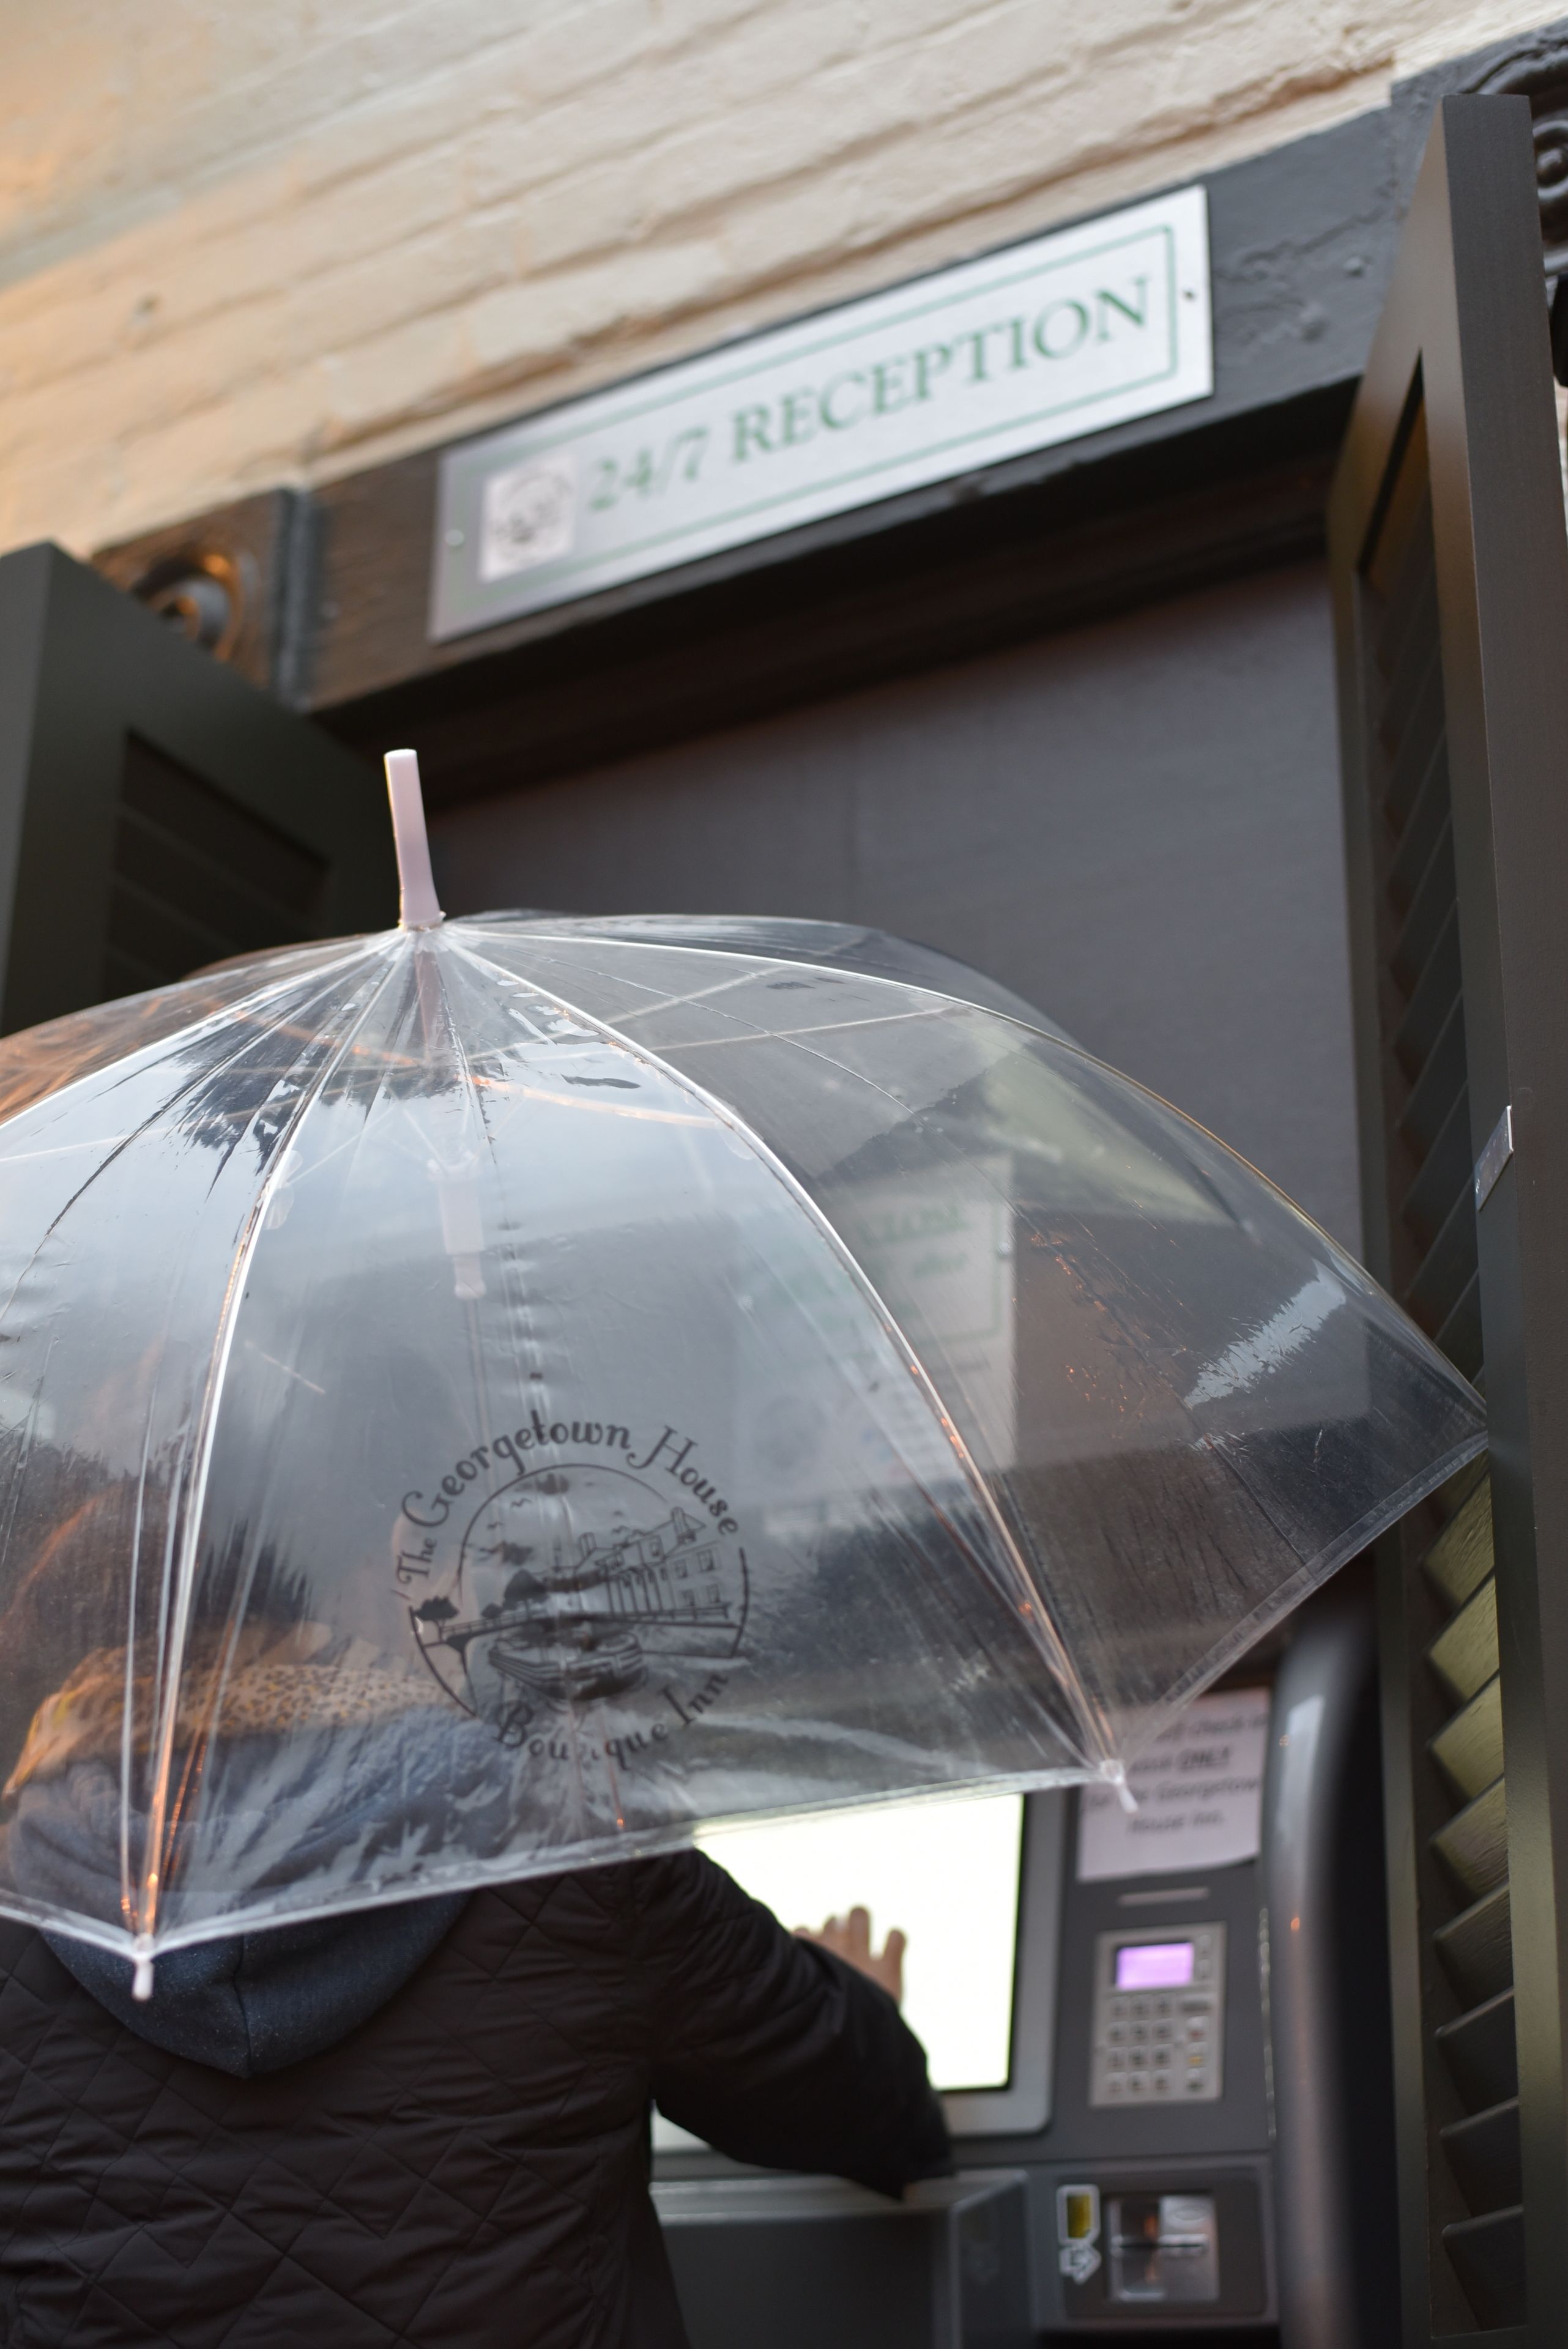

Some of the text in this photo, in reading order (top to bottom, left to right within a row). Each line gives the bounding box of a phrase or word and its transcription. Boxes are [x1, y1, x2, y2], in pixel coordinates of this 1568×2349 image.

[586, 274, 1151, 514] 24/7 RECEPTION
[395, 1409, 739, 1585] The Georgetown House
[494, 1671, 730, 1772] Bouique Inn
